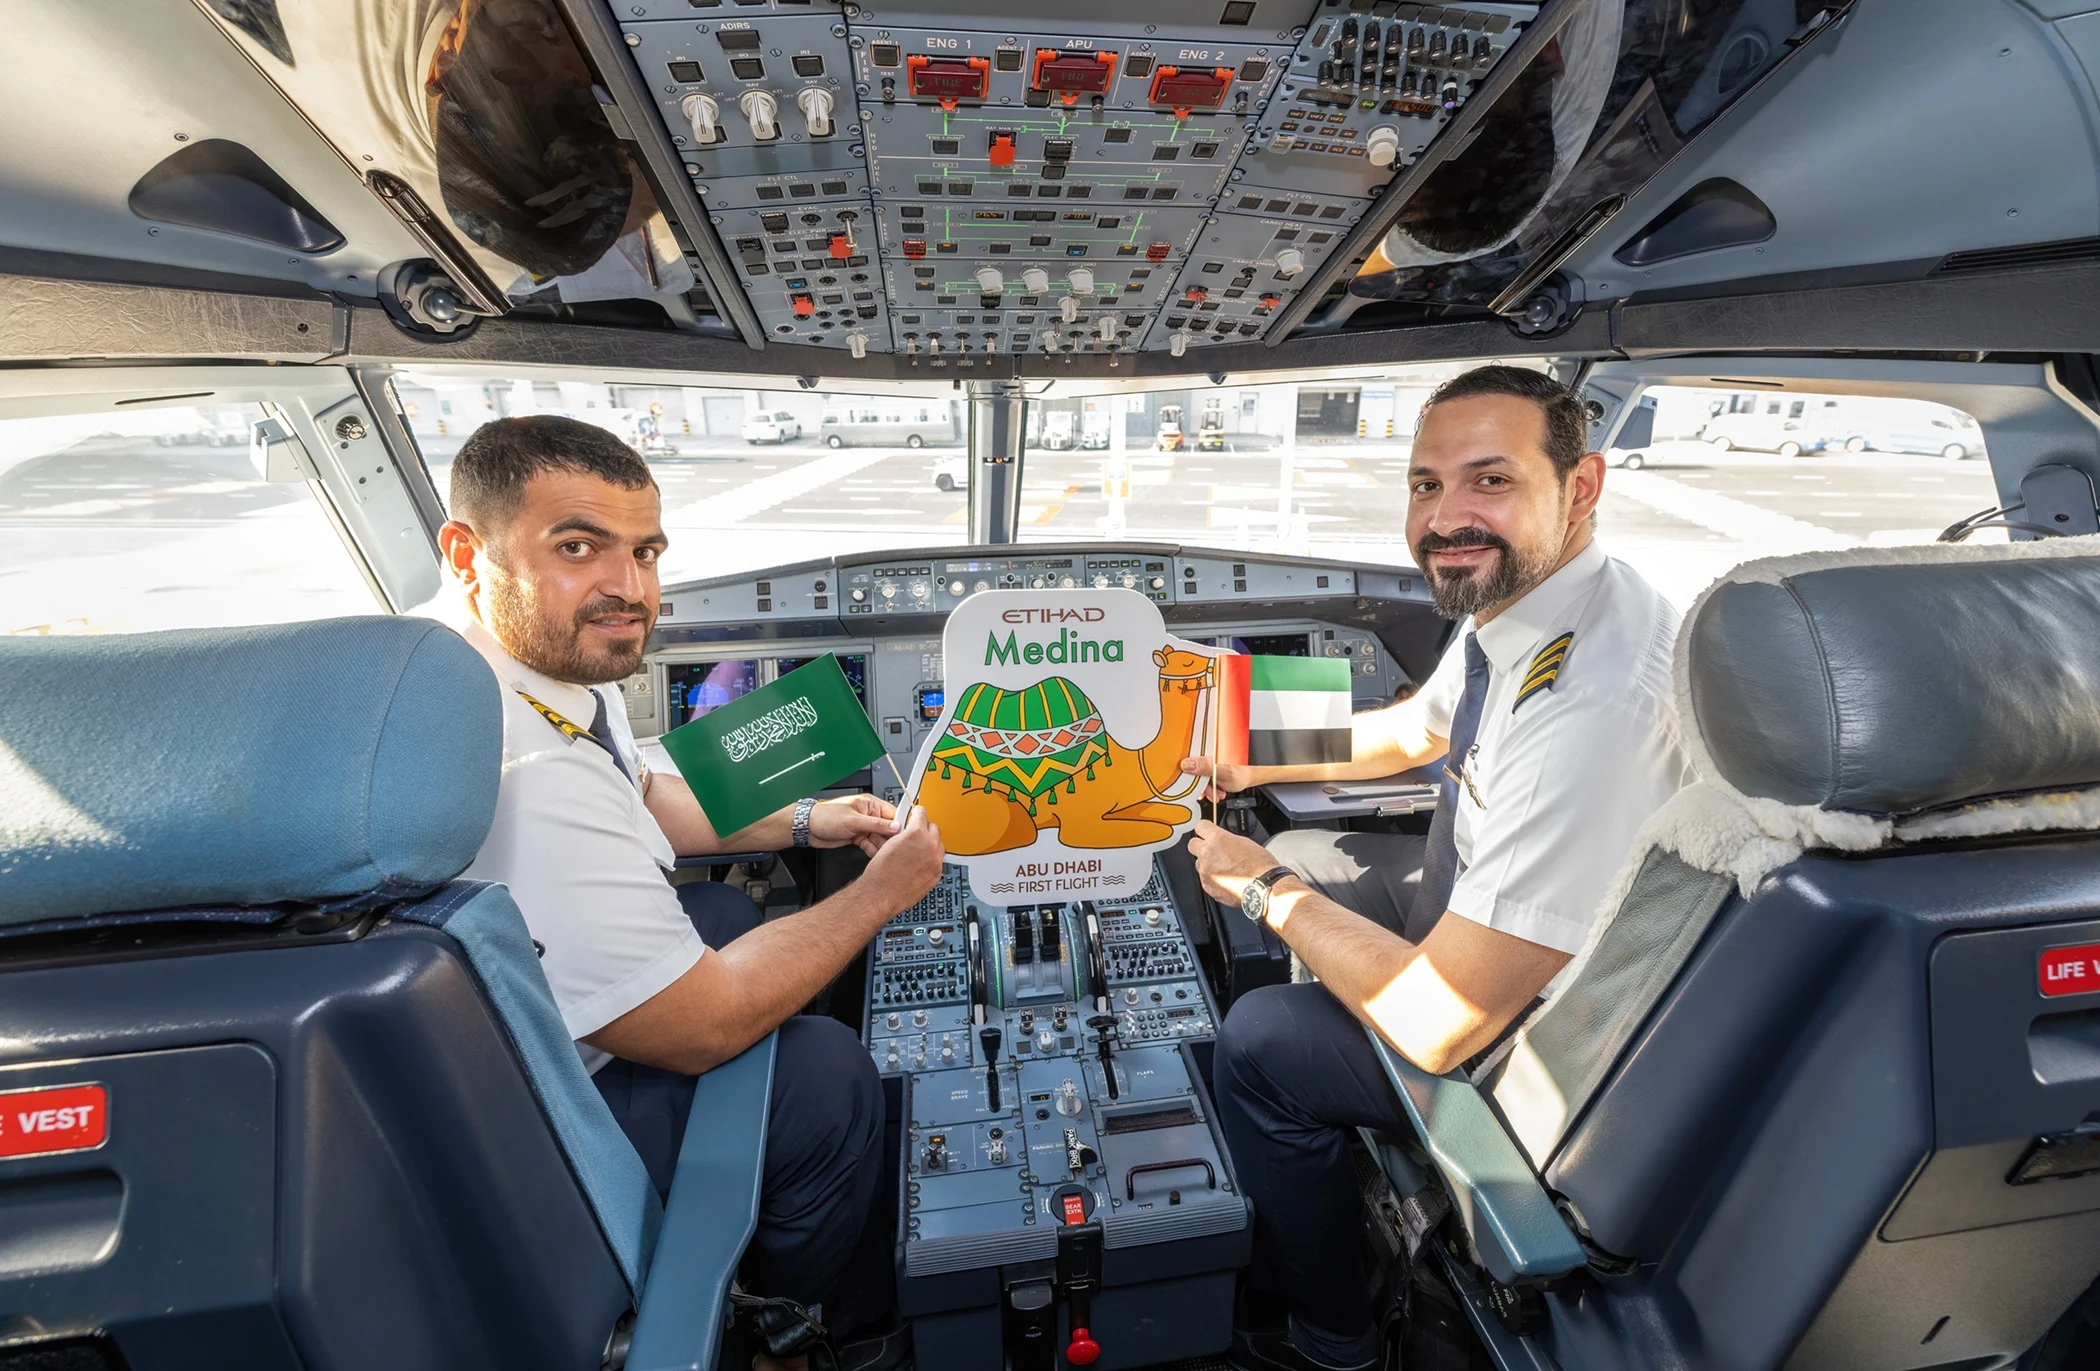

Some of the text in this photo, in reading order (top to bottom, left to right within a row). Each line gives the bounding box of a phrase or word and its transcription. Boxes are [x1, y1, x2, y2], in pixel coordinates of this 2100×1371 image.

[720, 22, 750, 30] ADIRS
[927, 38, 971, 49] ENG 1
[1066, 39, 1093, 49] APU
[1179, 50, 1225, 61] ENG 2
[861, 51, 870, 81] FIRE
[1259, 68, 1276, 96] FIRE
[1002, 607, 1105, 624] ETIHAD
[984, 627, 1124, 667] Medina
[1016, 859, 1102, 877] ABU DHABI
[1018, 876, 1099, 893] FIRST FLIGHT
[2047, 961, 2086, 981] LIFE
[17, 1105, 94, 1134] VEST
[1066, 1128, 1079, 1166] PARK BRK
